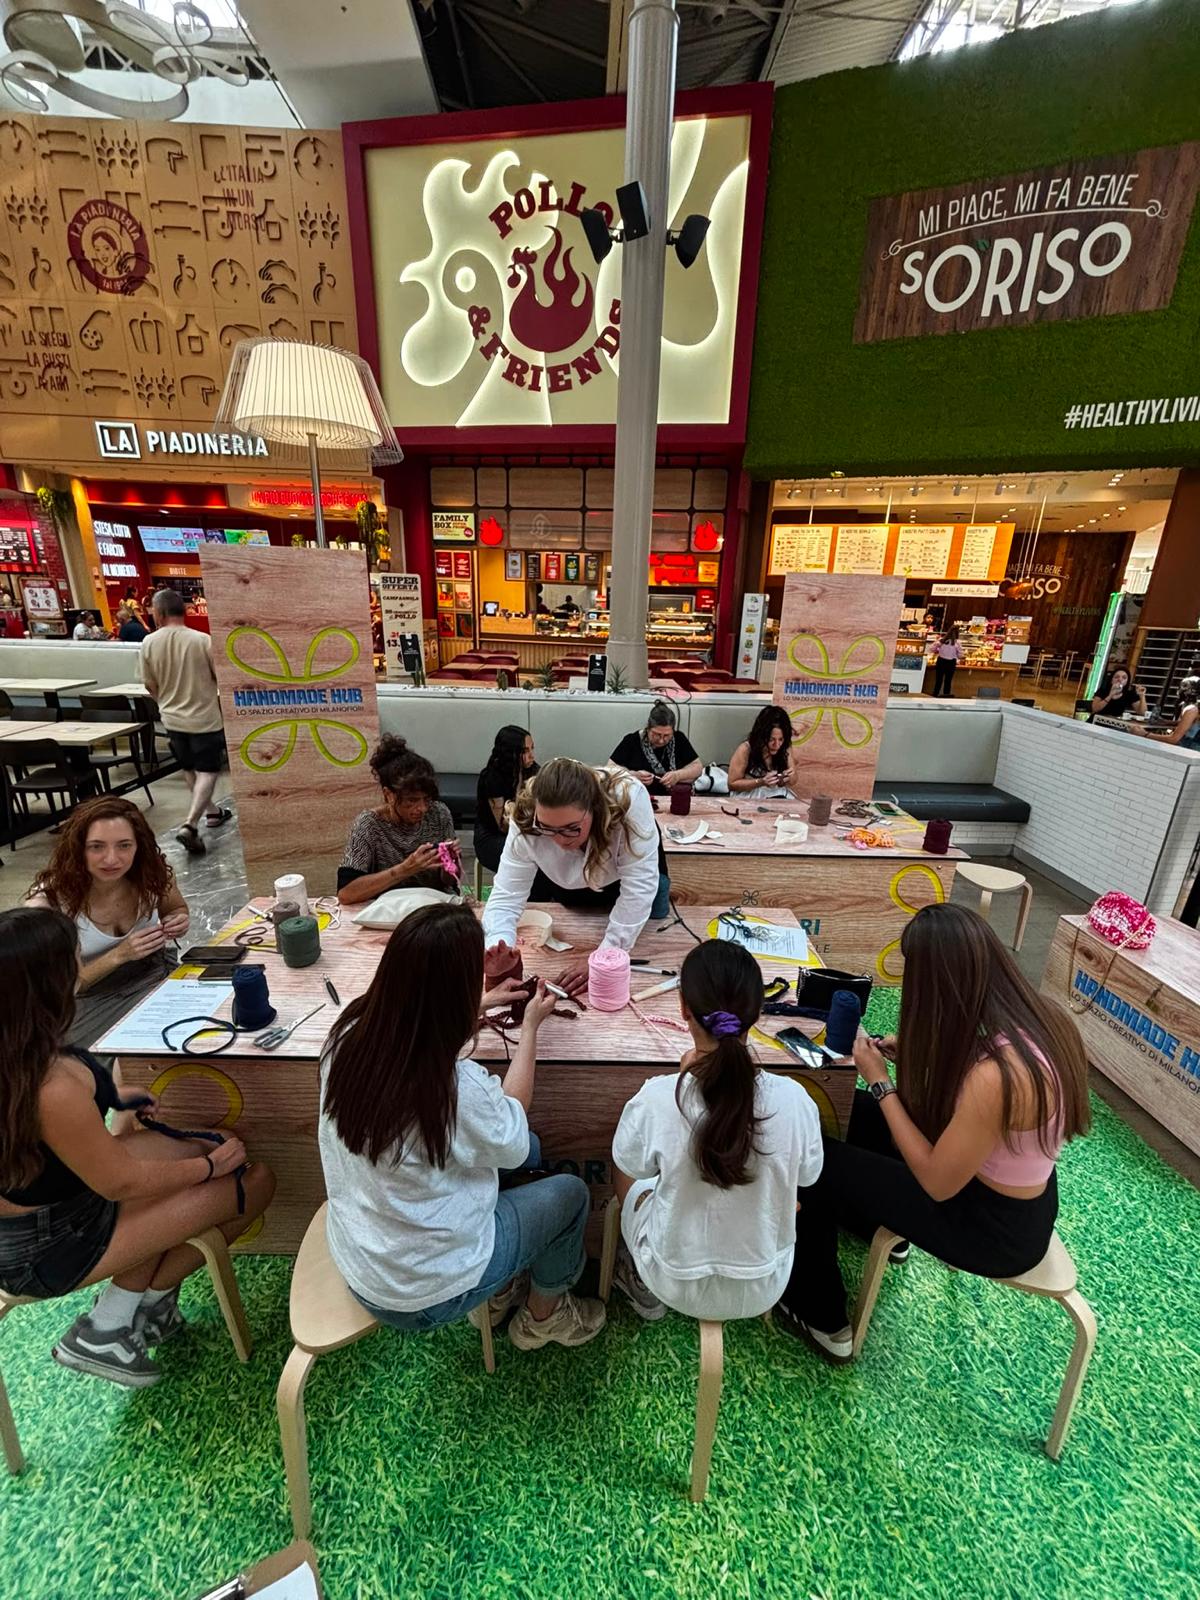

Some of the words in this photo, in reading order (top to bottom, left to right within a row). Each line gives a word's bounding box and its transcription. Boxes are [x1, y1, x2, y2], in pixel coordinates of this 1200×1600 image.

[918, 209, 941, 237] MI
[947, 187, 1008, 228] PIACE,
[1013, 180, 1041, 213] MI
[1044, 177, 1071, 210] FA
[1076, 173, 1139, 207] BENE
[899, 221, 1132, 317] SORISO
[467, 305, 491, 340] &
[103, 428, 133, 451] LA
[146, 430, 269, 457] PIADINERIA
[433, 514, 470, 522] FAMILY
[382, 576, 419, 585] SUPER
[233, 688, 328, 707] HANDMADE
[330, 688, 364, 704] HUB
[784, 681, 852, 697] HANDMADE
[853, 684, 879, 697] HUB
[248, 708, 274, 716] SPAZIO
[275, 707, 310, 715] CREATIVO
[1071, 991, 1081, 1002] LO
[1107, 1019, 1147, 1053] CREATIVO
[1147, 1049, 1158, 1062] DI
[1073, 969, 1181, 1061] HANDMADE
